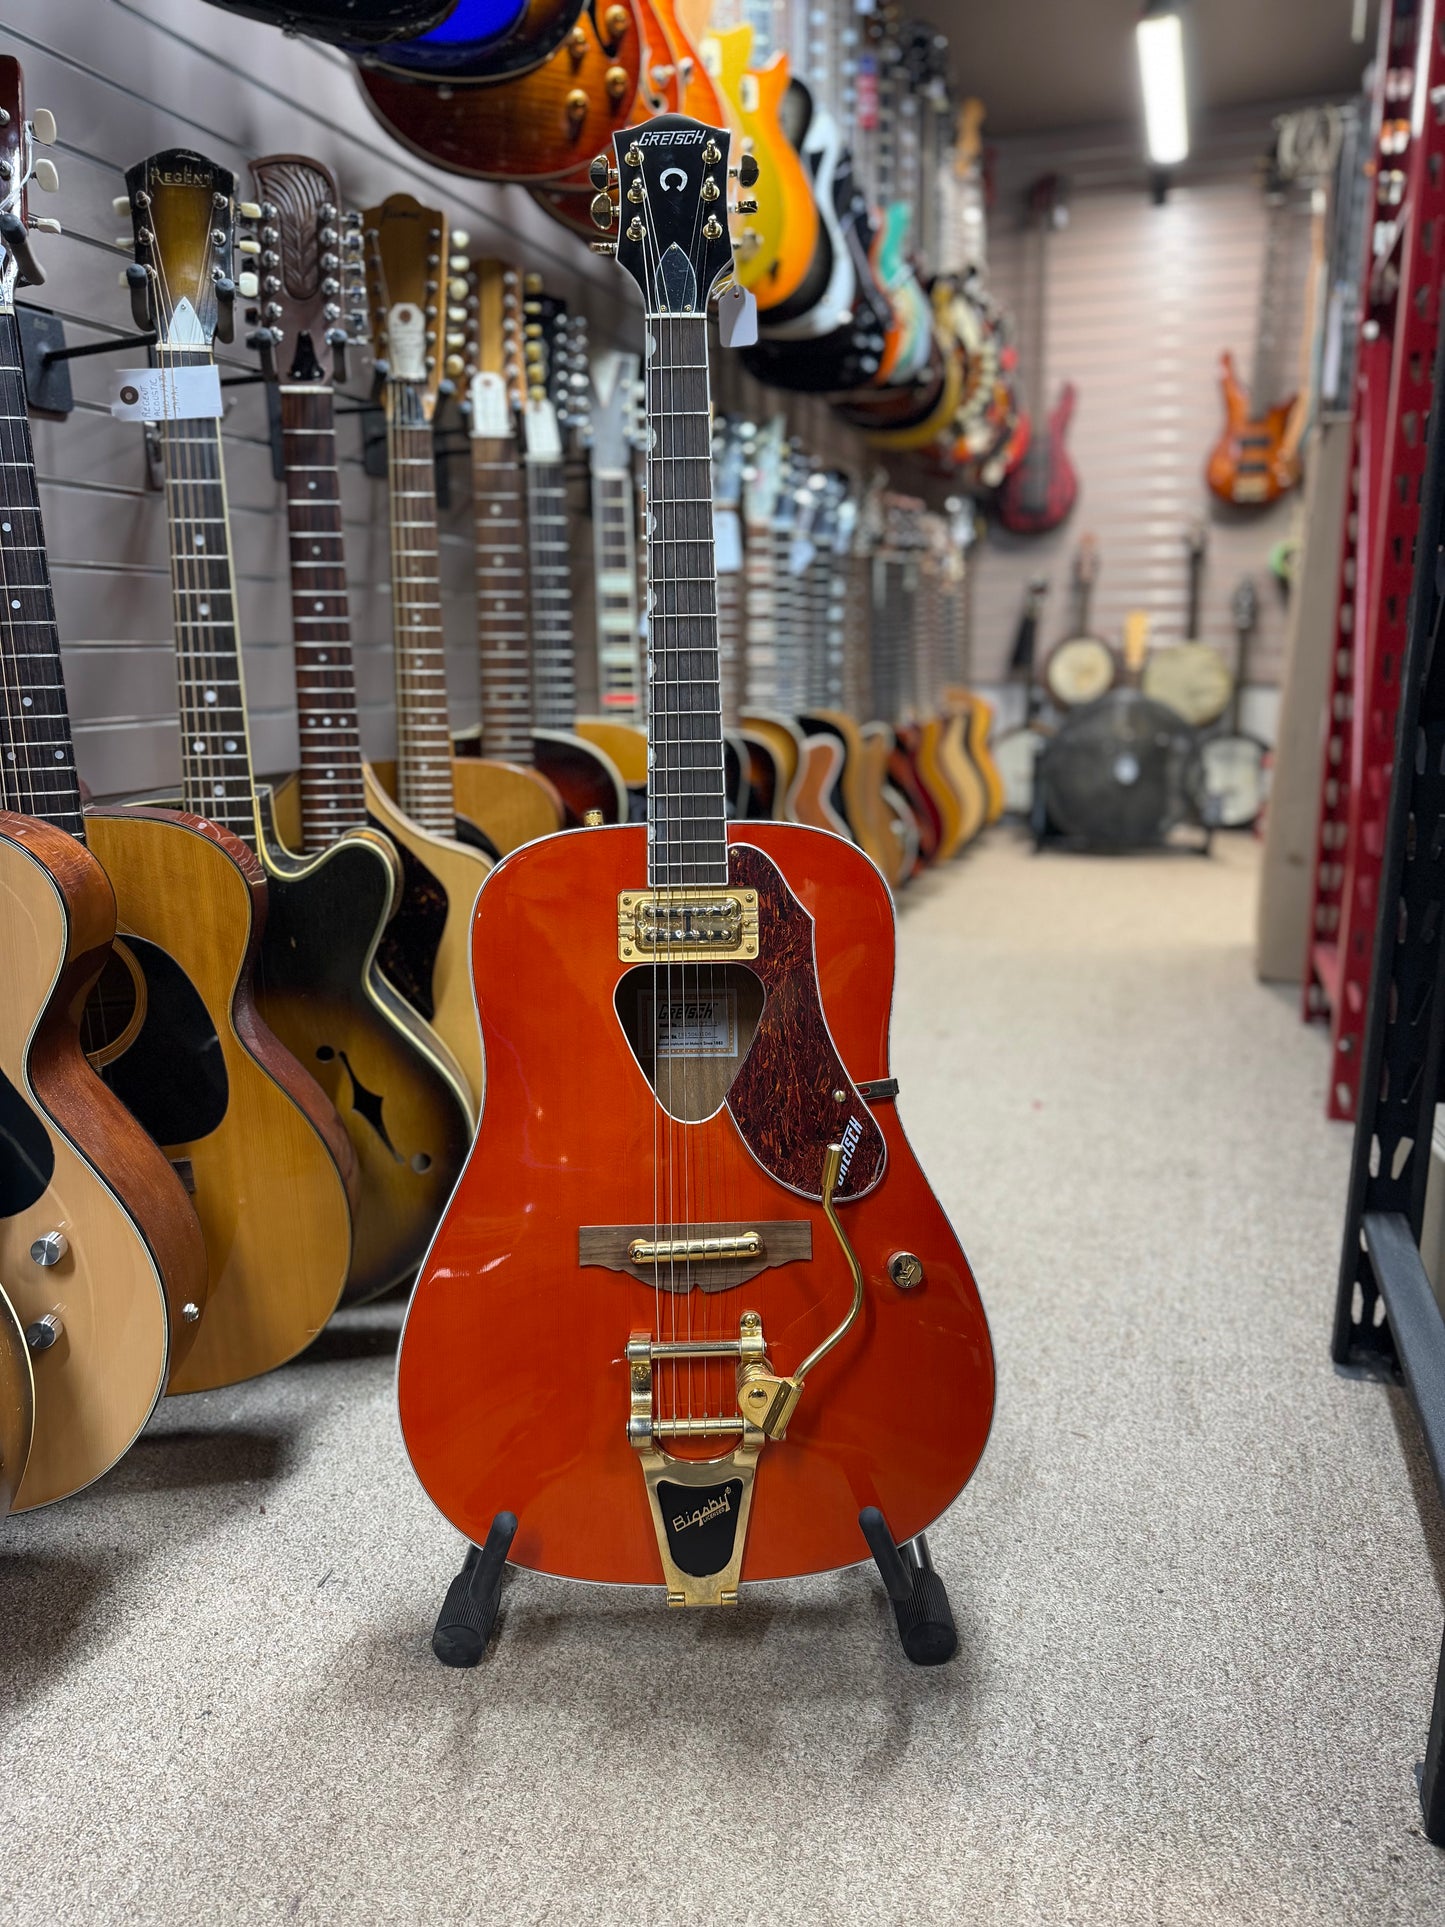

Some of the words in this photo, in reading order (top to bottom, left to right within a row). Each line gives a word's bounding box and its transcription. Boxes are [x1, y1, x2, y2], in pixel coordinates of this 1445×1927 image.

[638, 129, 706, 146] GRETSCH
[139, 384, 151, 417] REGENT
[149, 377, 161, 417] ACOUSTIC
[658, 1003, 716, 1019] GRETSCH
[672, 1492, 731, 1532] Bigsby
[702, 1507, 725, 1523] LICENSED
